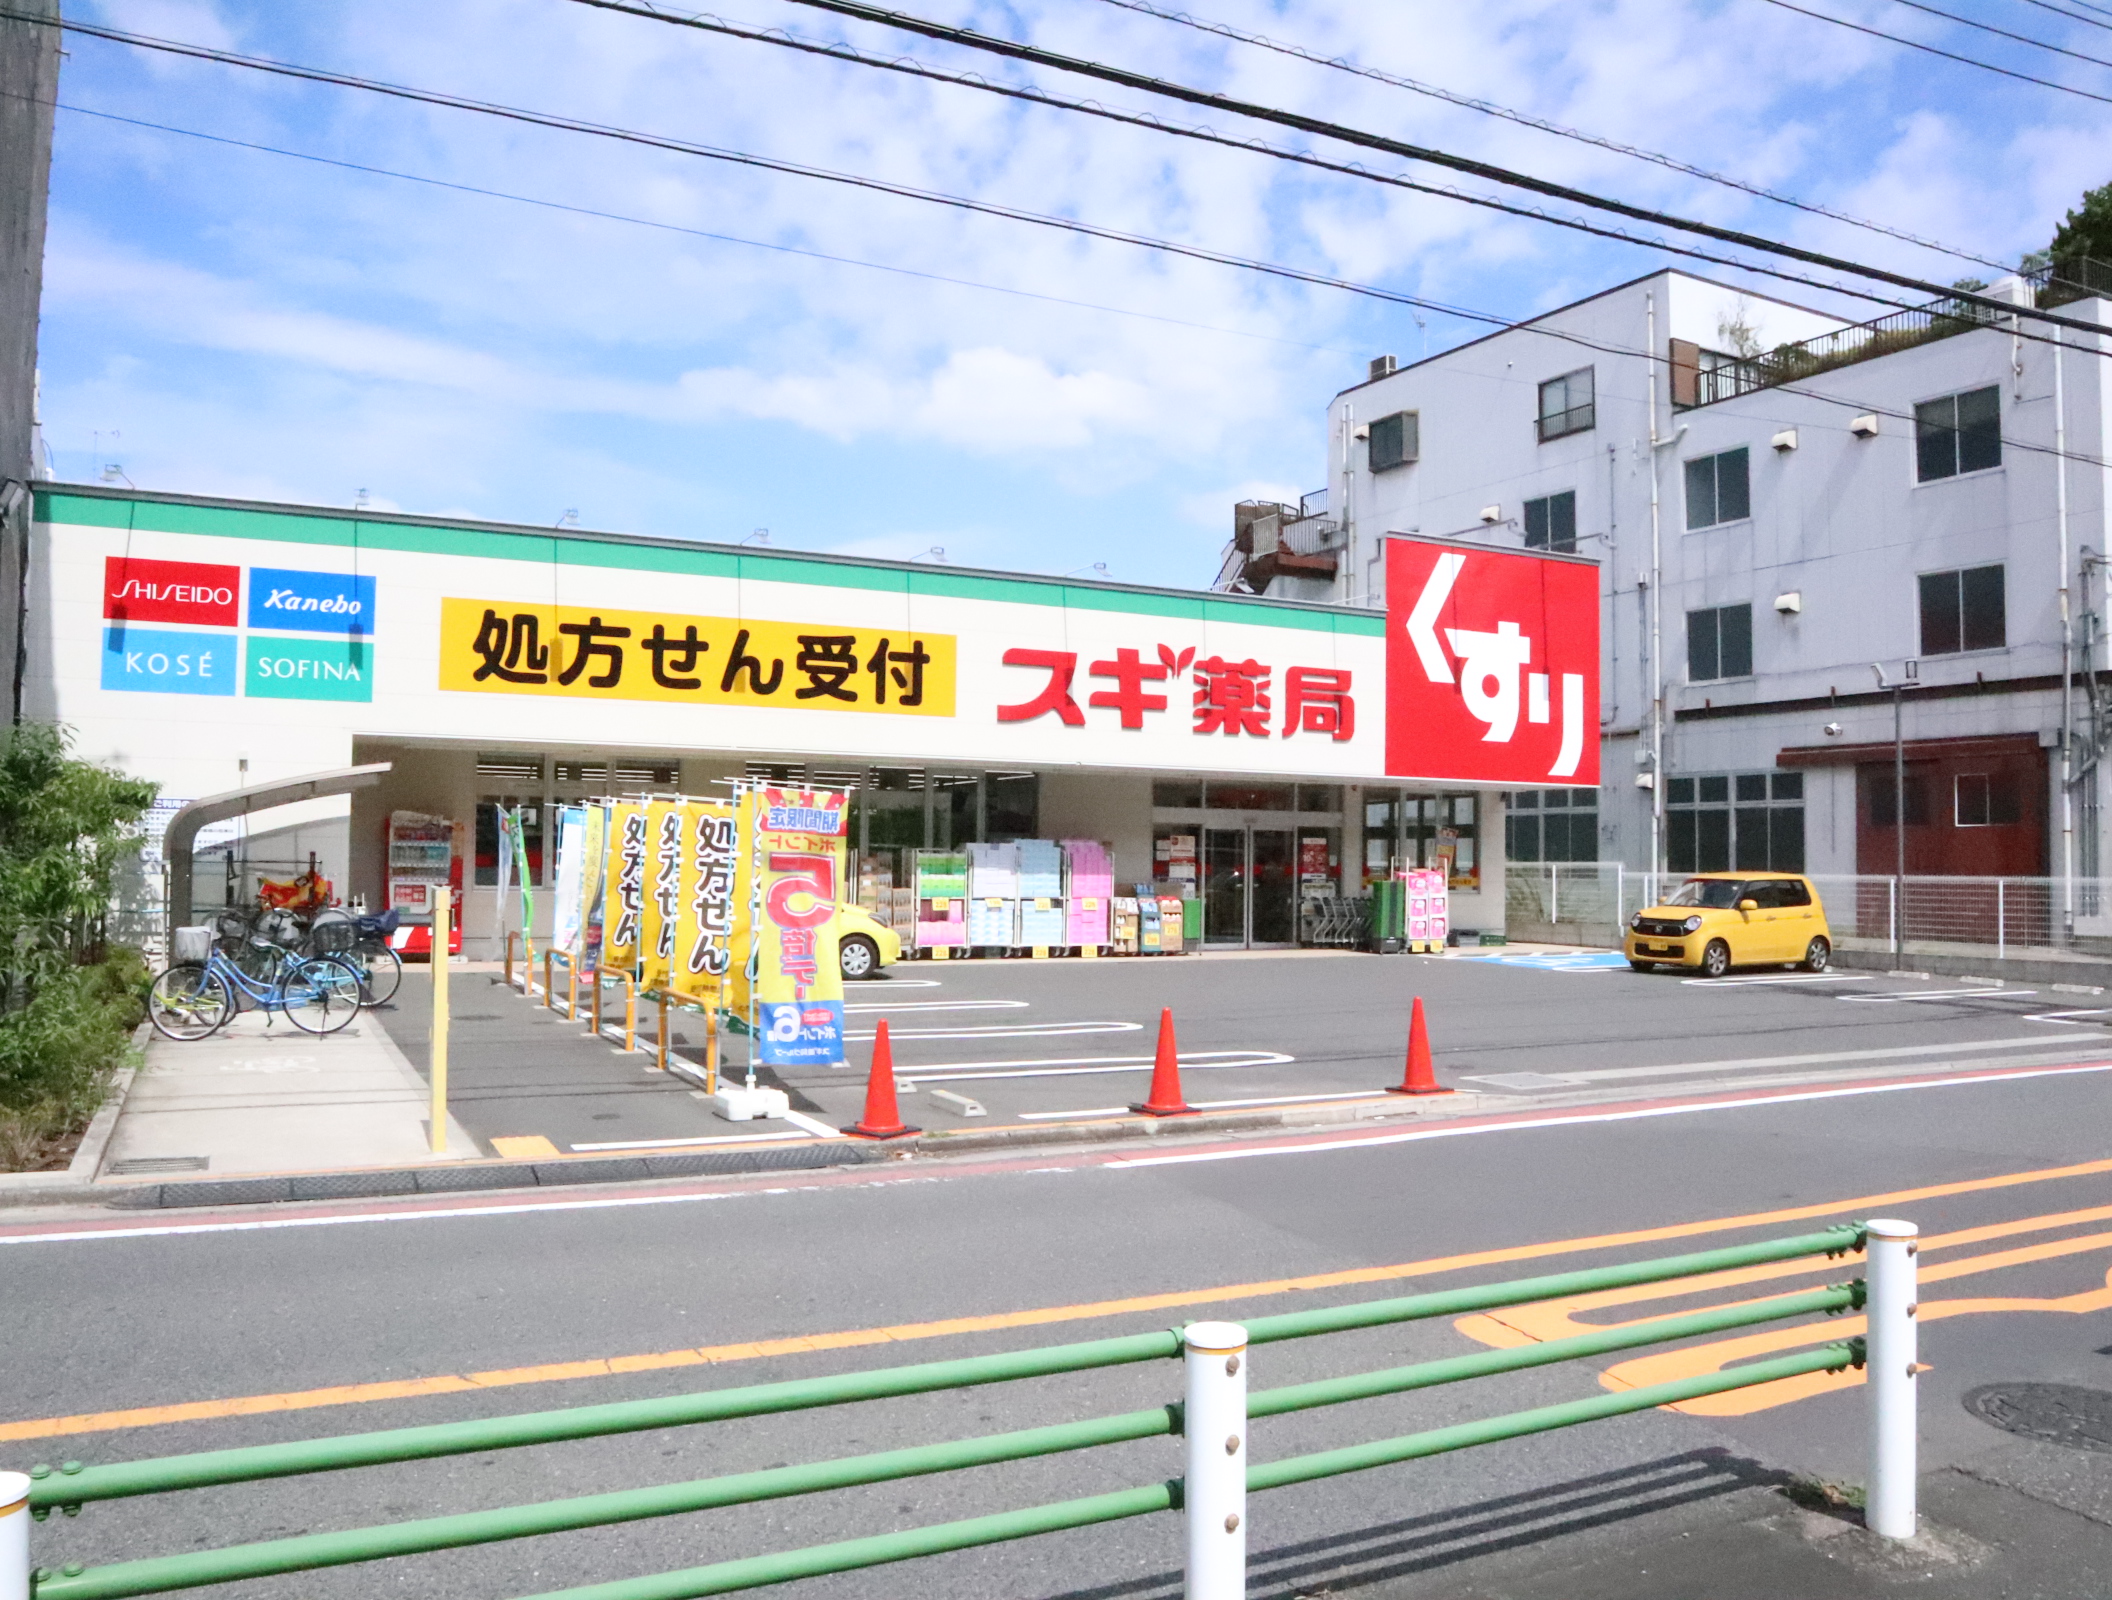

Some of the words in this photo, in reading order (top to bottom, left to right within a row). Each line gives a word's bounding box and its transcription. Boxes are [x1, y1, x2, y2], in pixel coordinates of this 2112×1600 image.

[111, 579, 233, 605] SHISEIDO
[263, 588, 363, 615] Kanebo
[126, 650, 213, 678] KOSÉ
[258, 656, 361, 682] SOFINA
[473, 609, 931, 707] 処方せん受付
[1406, 553, 1584, 776] くすり
[996, 644, 1355, 742] スギ薬局
[688, 814, 740, 975] 処方せん
